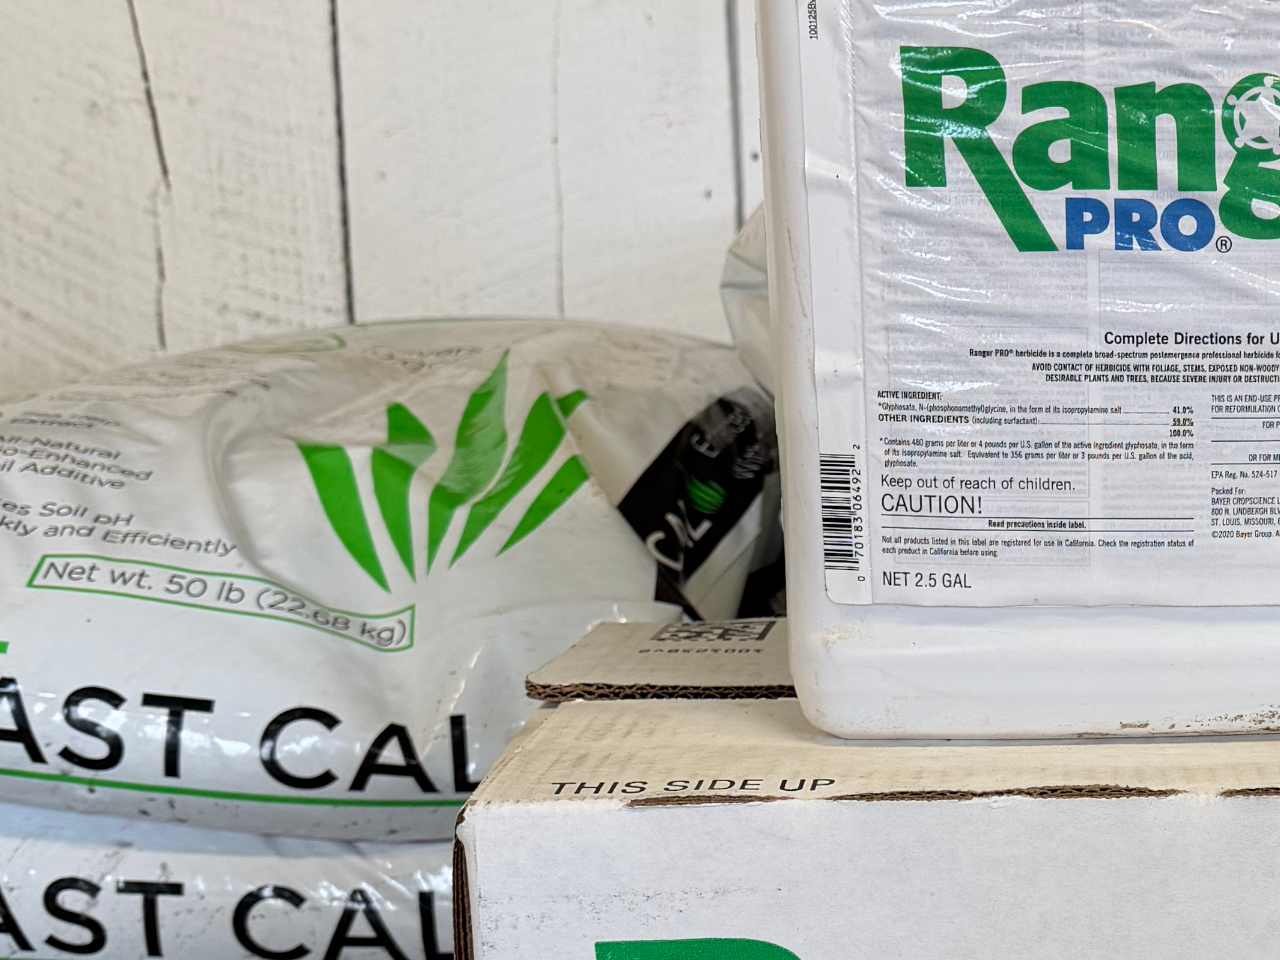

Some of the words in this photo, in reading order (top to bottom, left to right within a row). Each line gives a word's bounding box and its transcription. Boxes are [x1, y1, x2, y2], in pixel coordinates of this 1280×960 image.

[1104, 332, 1169, 346] Complete
[1174, 332, 1242, 345] Directions
[1247, 332, 1264, 345] for
[969, 349, 993, 358] Ranger
[1015, 349, 1047, 357] herbicide
[1201, 351, 1242, 359] professional
[1243, 351, 1274, 359] herbicide
[1032, 363, 1052, 371] AVOID
[1053, 363, 1083, 371] CONTACT
[1084, 364, 1093, 372] OF
[1095, 364, 1131, 372] HERBICIDE
[1133, 364, 1150, 372] WITH
[1208, 364, 1238, 372] EXPOSED
[1045, 374, 1082, 382] DESIRABLE
[1084, 374, 1109, 382] PLANTS
[1150, 375, 1180, 383] BECAUSE
[1182, 375, 1207, 383] SEVERE
[1208, 375, 1231, 383] INJURY
[1233, 375, 1242, 383] OR
[878, 414, 907, 422] OTHER
[910, 415, 969, 423] INGREDIENTS
[20, 461, 126, 489] Additive
[881, 475, 912, 489] Keep
[917, 477, 938, 488] out
[942, 476, 955, 489] of
[959, 478, 996, 489] reach
[1001, 477, 1014, 489] of
[1018, 478, 1075, 490] children.
[851, 469, 862, 510] 06492
[881, 494, 982, 513] CAUTION!
[39, 501, 88, 518] Soil
[93, 512, 135, 527] pH
[1046, 519, 1067, 528] inside
[1068, 519, 1086, 528] label.
[43, 523, 97, 538] and
[101, 528, 239, 557] Efficiently
[853, 517, 864, 557] 70183
[882, 572, 910, 586] NET
[915, 573, 937, 587] 2.5
[942, 573, 971, 588] GAL
[41, 561, 96, 583] Net
[110, 568, 153, 590] wt.
[163, 574, 207, 599] 50
[216, 580, 246, 605] lb
[255, 586, 350, 632] (22.68
[359, 616, 408, 648] kg)
[550, 781, 648, 796] THIS
[662, 778, 765, 792] SIDE
[778, 777, 837, 792] UP
